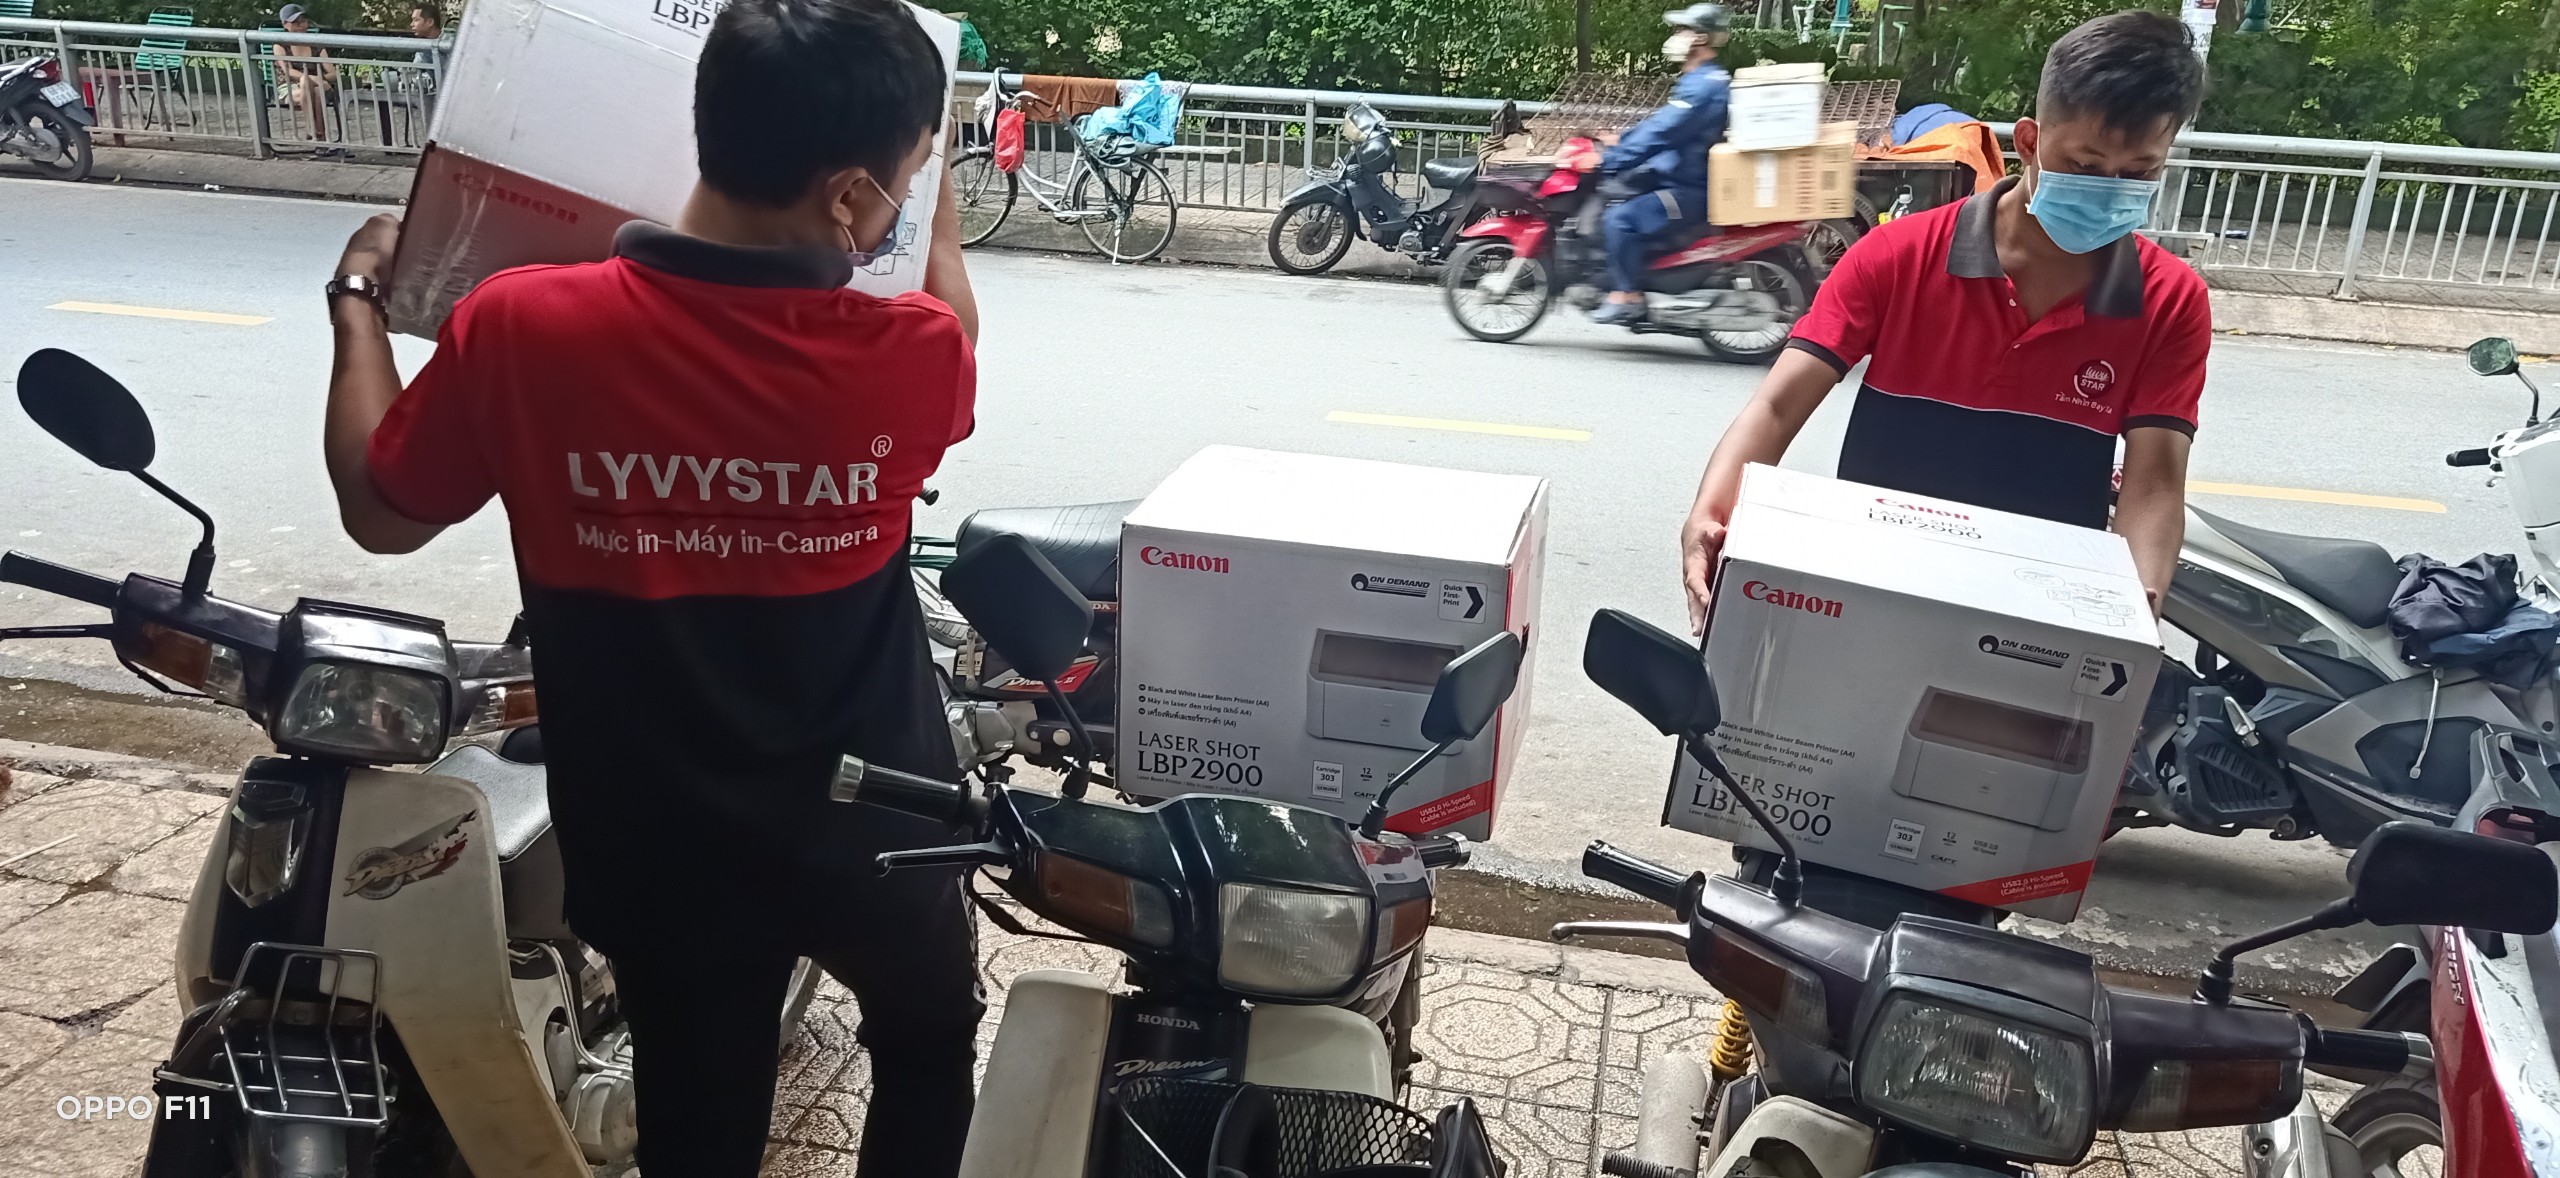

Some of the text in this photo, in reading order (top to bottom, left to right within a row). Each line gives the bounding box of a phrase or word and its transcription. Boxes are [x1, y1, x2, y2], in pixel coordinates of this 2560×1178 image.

[2080, 378, 2106, 391] STAR
[567, 451, 878, 506] LYVYSTAR
[1874, 497, 1970, 521] Canon
[1140, 546, 1230, 573] Canon
[1369, 575, 1431, 589] ON DEMAND
[1443, 583, 1463, 592] Quick
[1443, 598, 1460, 607] Print
[1742, 580, 1844, 619] Canon
[2001, 639, 2070, 660] ON DEMAND
[2085, 657, 2107, 668] Quick
[2080, 672, 2099, 682] Print
[1178, 690, 1196, 698] White
[1234, 697, 1255, 705] Printer
[1256, 699, 1270, 707] (A4)
[1138, 731, 1261, 761] LASER SHOT
[1739, 725, 1753, 733] and
[1754, 728, 1774, 739] White
[1775, 733, 1794, 744] Laser
[1795, 738, 1815, 748] Beam
[1815, 742, 1839, 754] Printer
[1840, 748, 1856, 758] (A4)
[1743, 738, 1762, 748] laser
[1320, 773, 1335, 782] 303
[1362, 767, 1371, 775] 12
[1771, 783, 1835, 811] SHOT
[1897, 832, 1913, 842] 303
[1946, 831, 1956, 840] 12
[1137, 1013, 1201, 1031] HONDA
[1114, 1059, 1216, 1077] Dream
